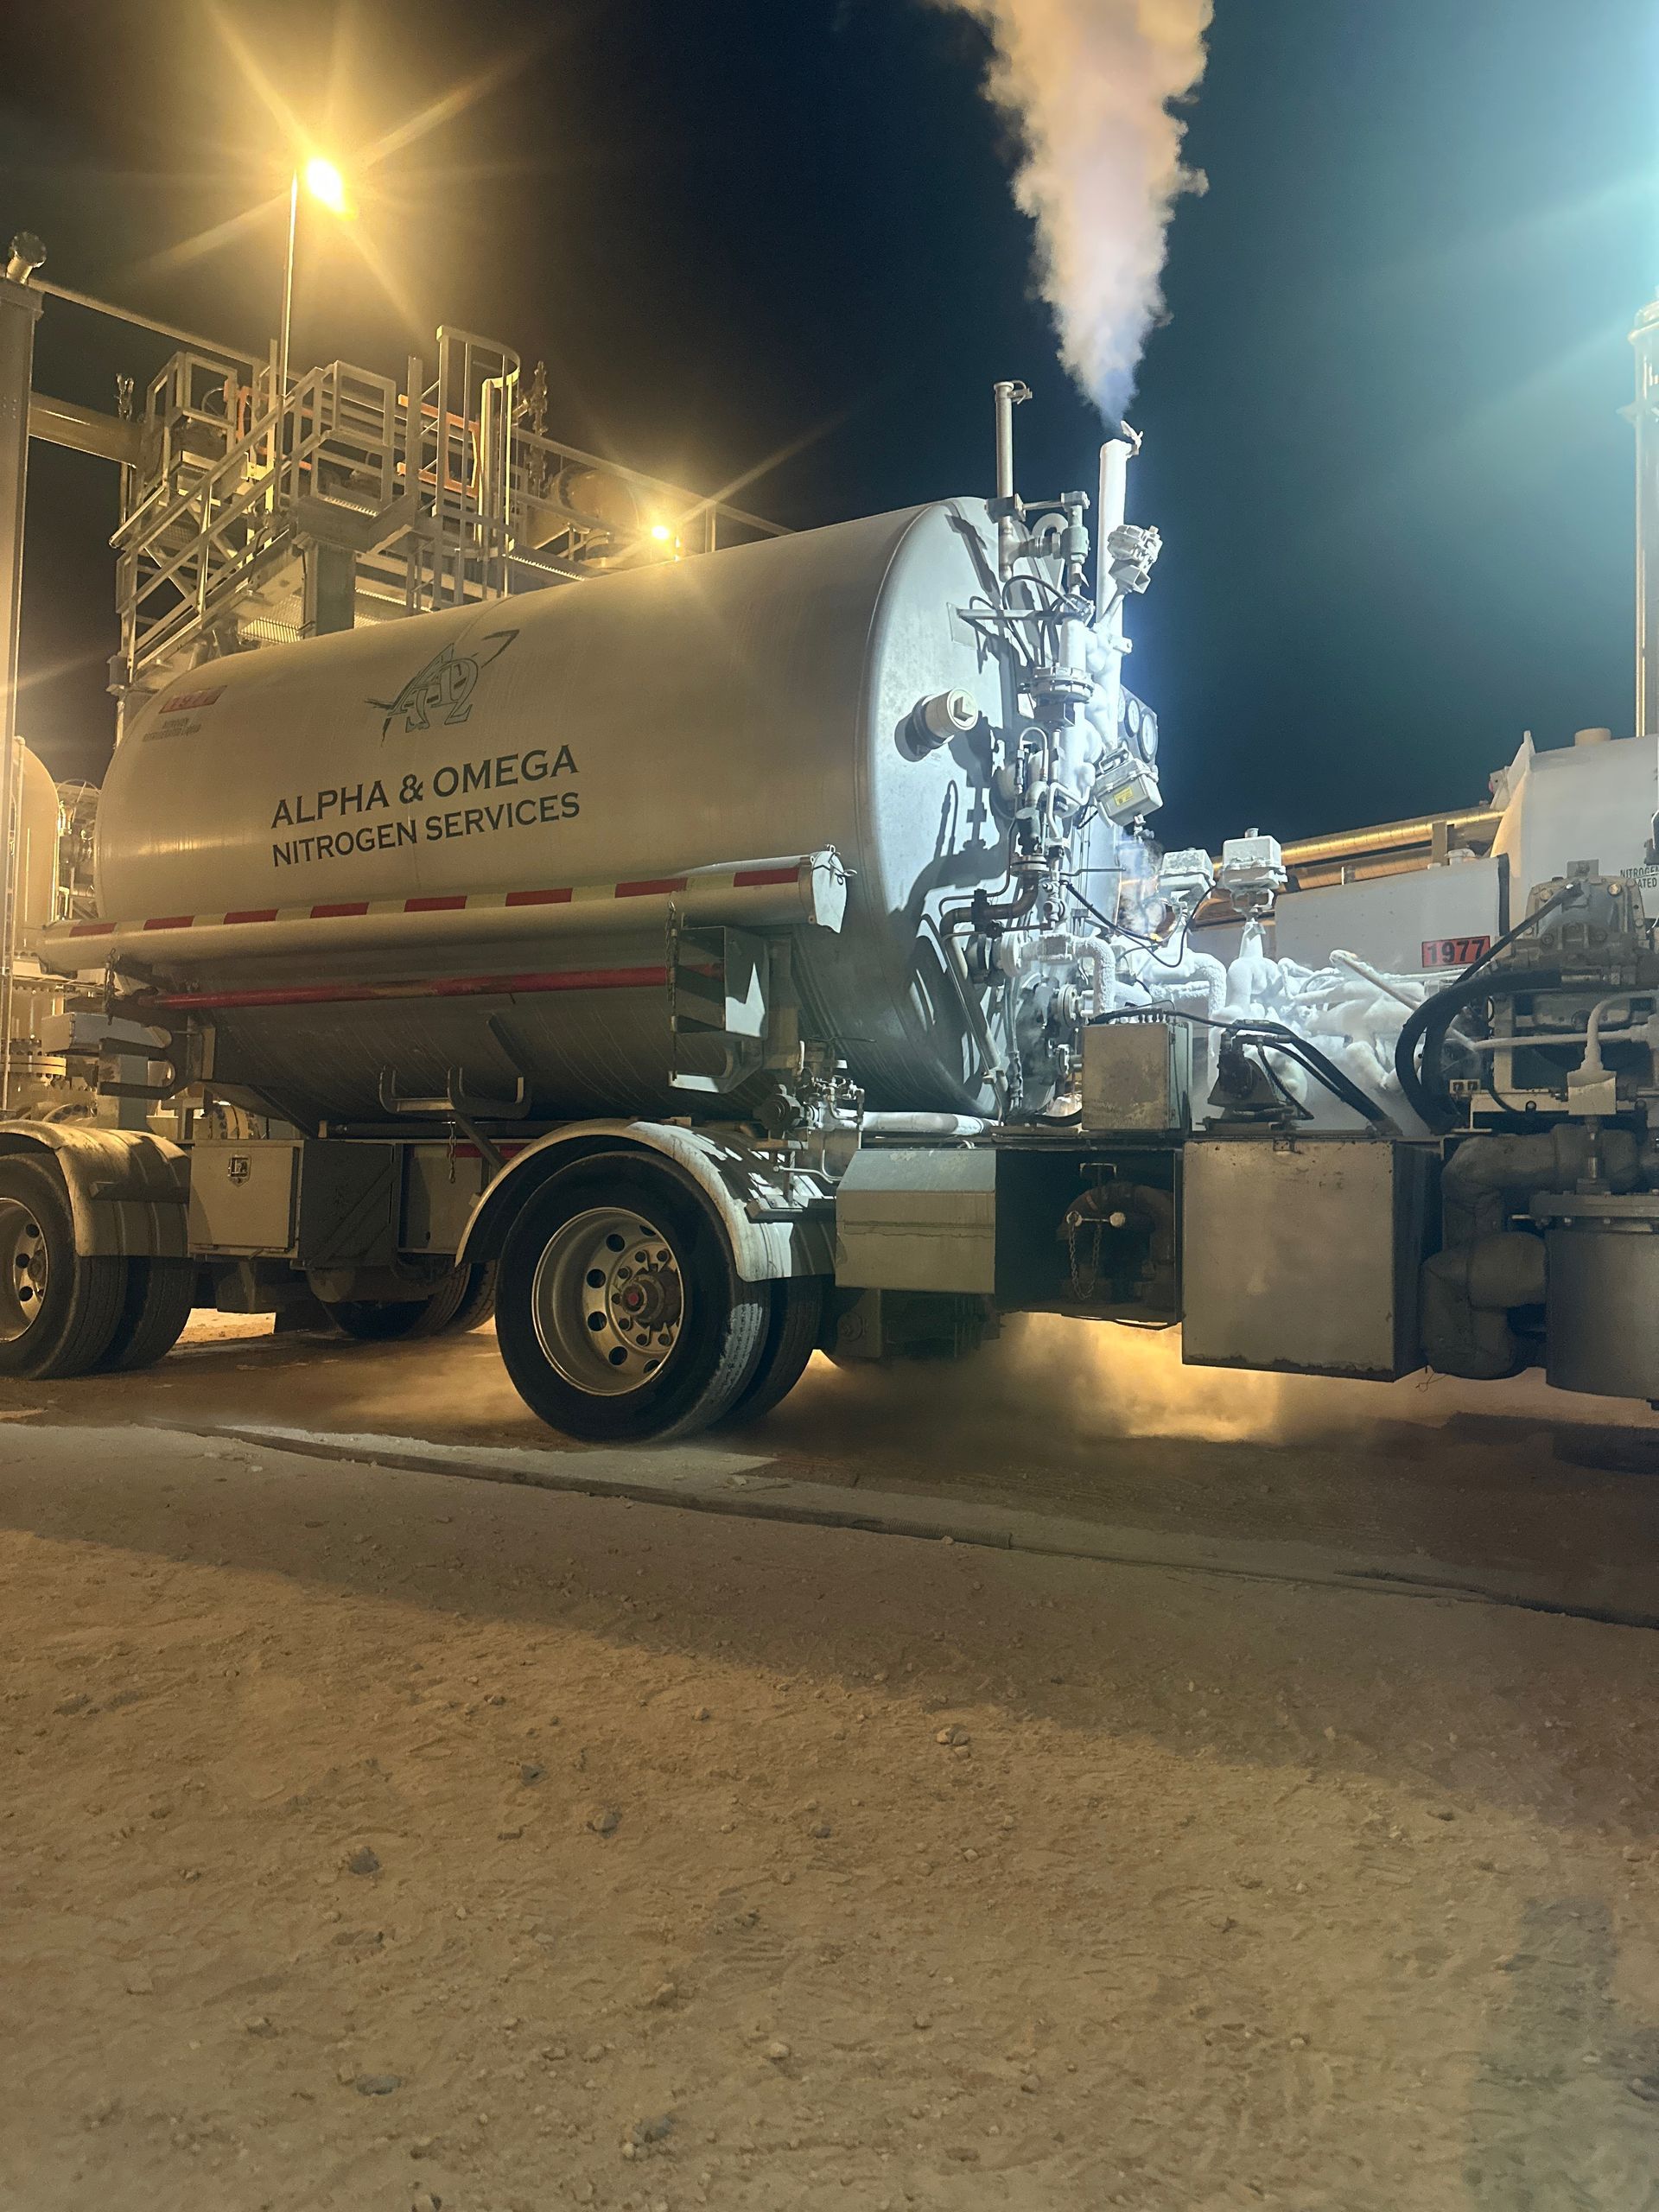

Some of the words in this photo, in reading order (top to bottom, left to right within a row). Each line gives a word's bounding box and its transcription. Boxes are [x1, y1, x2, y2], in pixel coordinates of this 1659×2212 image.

[270, 779, 391, 830] ALPHA
[399, 773, 423, 804] &
[433, 744, 580, 798] OMEGA
[272, 819, 417, 868] NITROGEN
[425, 791, 580, 842] SERVICES
[1427, 938, 1485, 964] 1977
